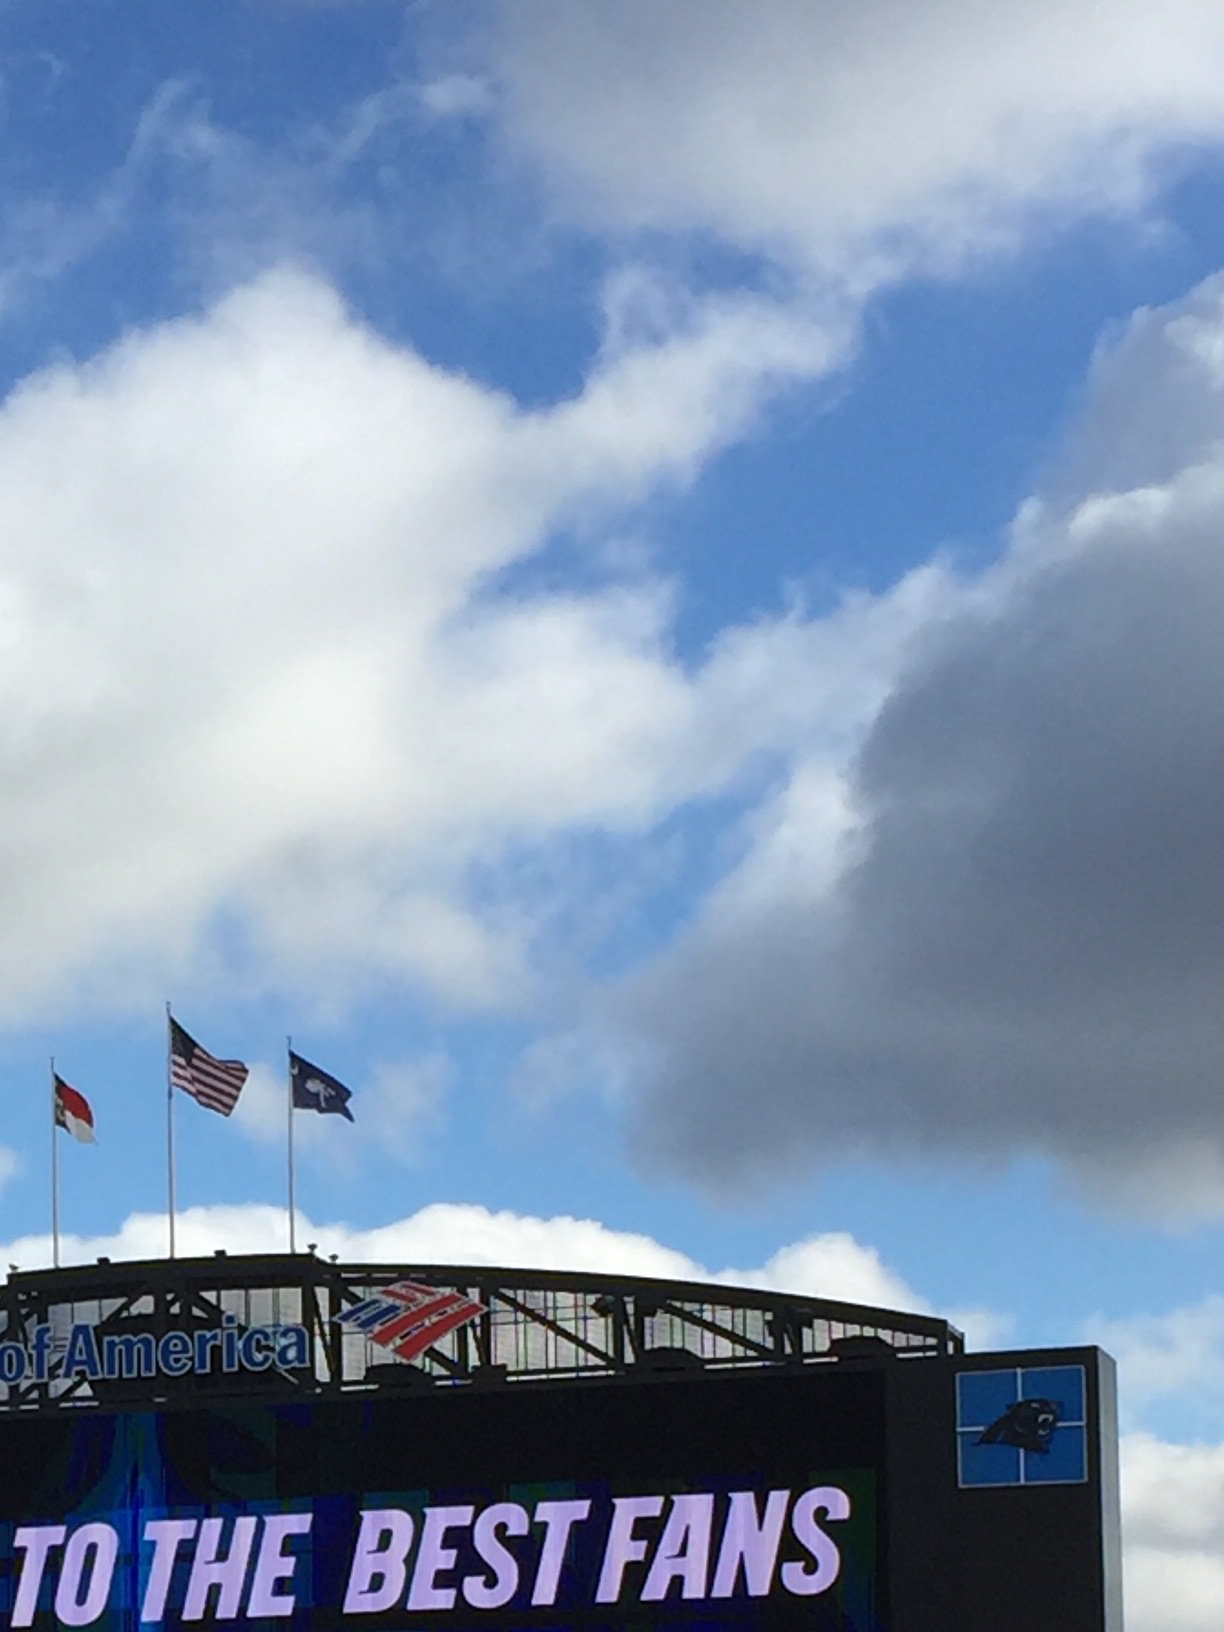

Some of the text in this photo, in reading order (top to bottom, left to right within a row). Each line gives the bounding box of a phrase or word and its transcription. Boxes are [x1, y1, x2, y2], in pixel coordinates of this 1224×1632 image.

[62, 1314, 310, 1380] America
[10, 1522, 118, 1628] TO
[141, 1513, 313, 1622] THE
[343, 1499, 591, 1614] BEST
[596, 1487, 851, 1603] FANS
